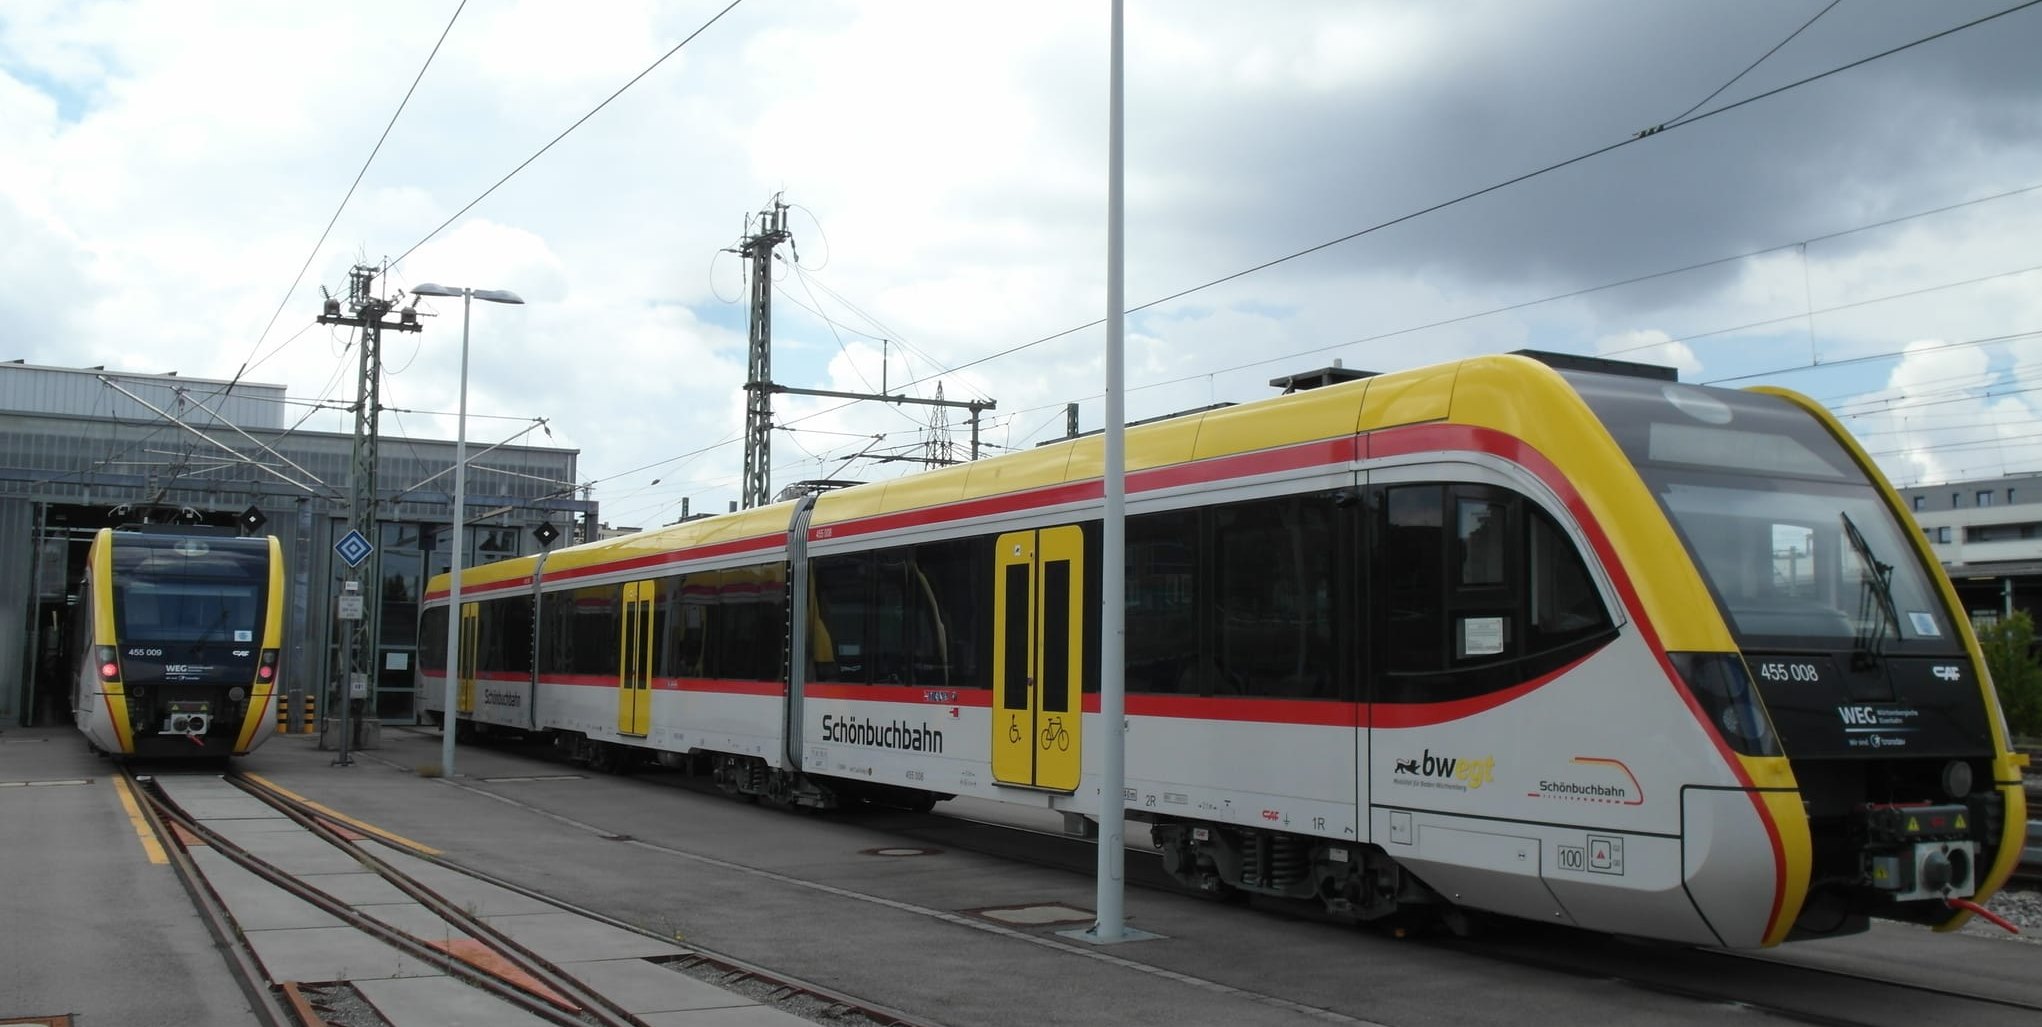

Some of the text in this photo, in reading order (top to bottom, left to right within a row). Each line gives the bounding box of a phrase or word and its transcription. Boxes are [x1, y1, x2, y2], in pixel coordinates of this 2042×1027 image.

[128, 648, 162, 656] 455 009
[165, 664, 188, 673] WEG
[1761, 663, 1819, 682] 455 008
[1838, 706, 1877, 725] WEG
[822, 714, 943, 754] Schönbuchbahn
[1422, 748, 1495, 790] bwegt
[1539, 780, 1626, 798] Schönbuchbahn
[1145, 794, 1157, 808] 2R
[1312, 816, 1326, 831] 1R
[1560, 849, 1583, 868] 100
